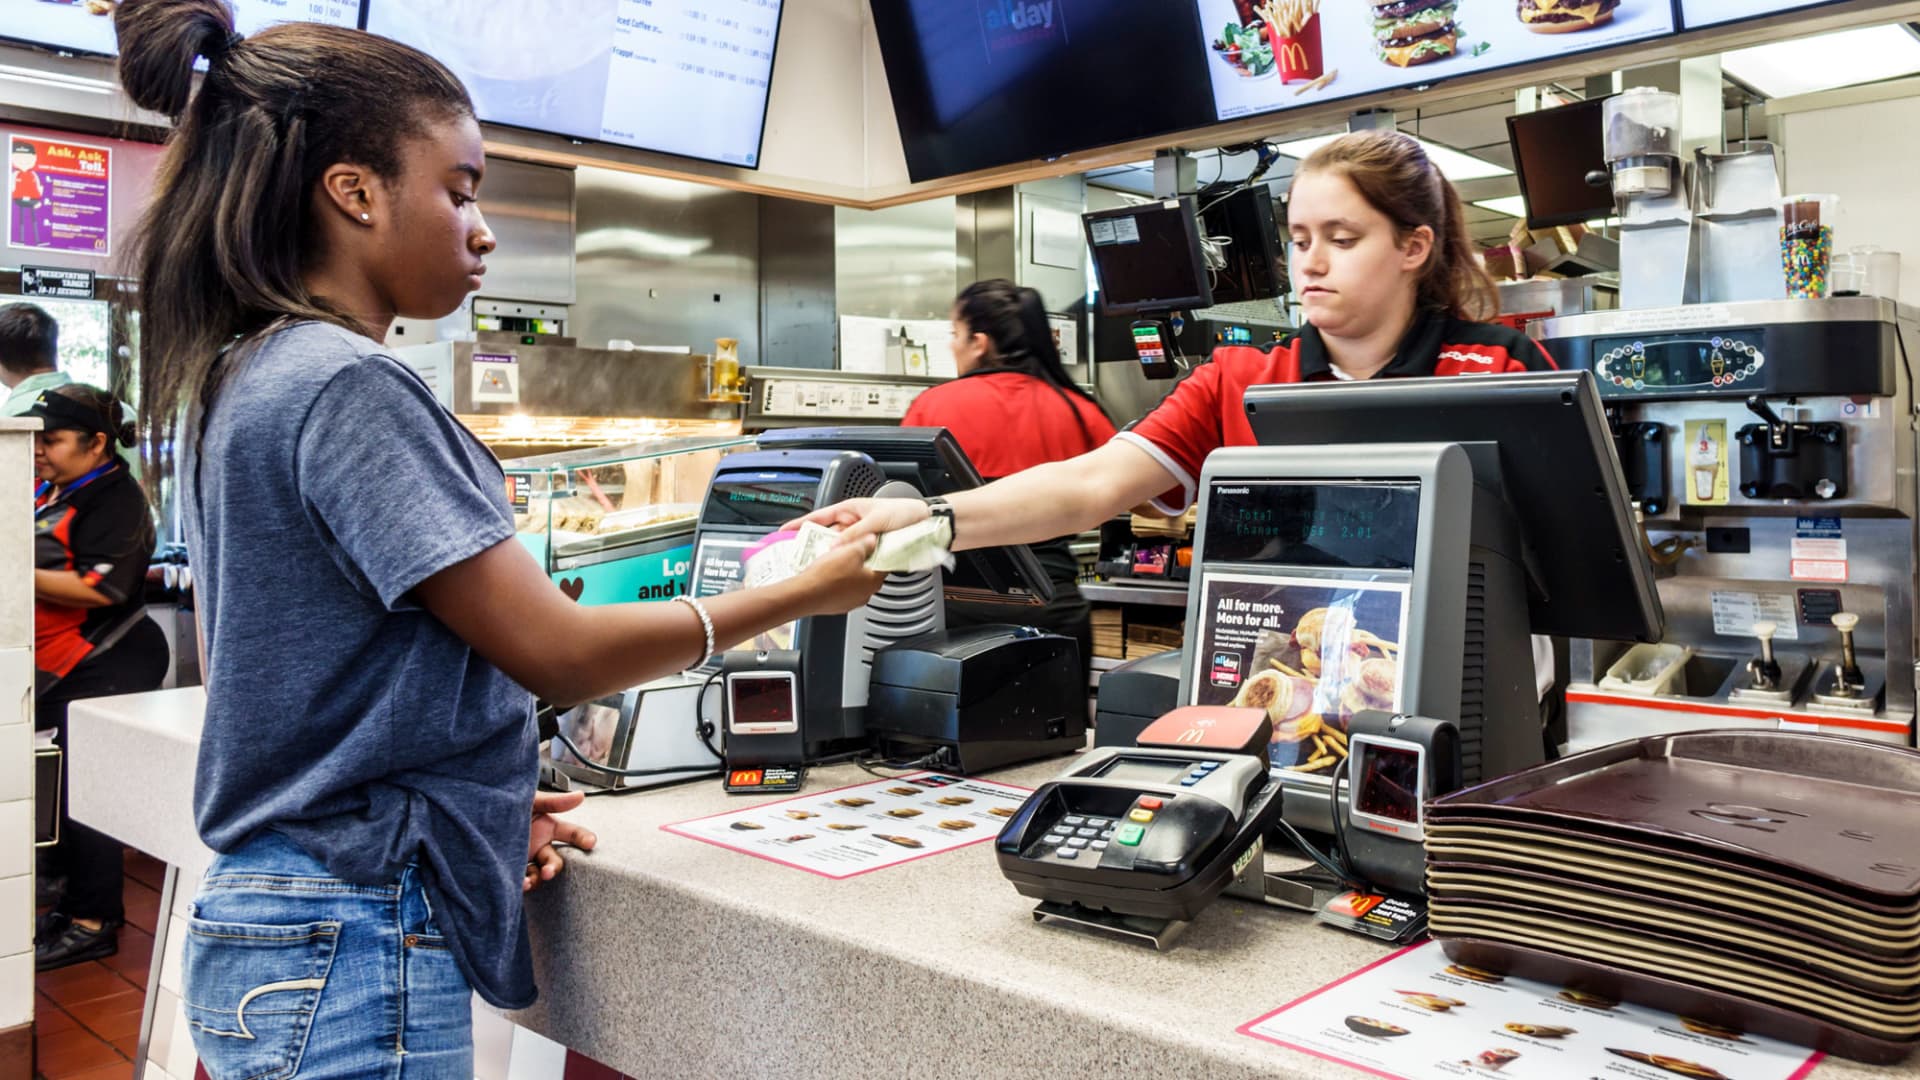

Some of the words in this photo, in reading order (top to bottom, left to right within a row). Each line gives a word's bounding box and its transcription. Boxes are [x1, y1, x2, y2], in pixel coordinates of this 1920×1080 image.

[47, 145, 76, 159] Ask.
[78, 149, 106, 163] Ask.
[78, 159, 105, 172] Tell.
[764, 385, 773, 411] Fries
[1699, 440, 1708, 451] 3
[1217, 487, 1250, 495] Panasonic
[1239, 508, 1272, 521] Total
[638, 579, 675, 599] and
[1217, 598, 1233, 611] All
[1234, 599, 1251, 612] for
[1252, 602, 1284, 614] more.
[1216, 611, 1244, 625] More
[1245, 613, 1262, 626] for
[1262, 615, 1281, 628] all.
